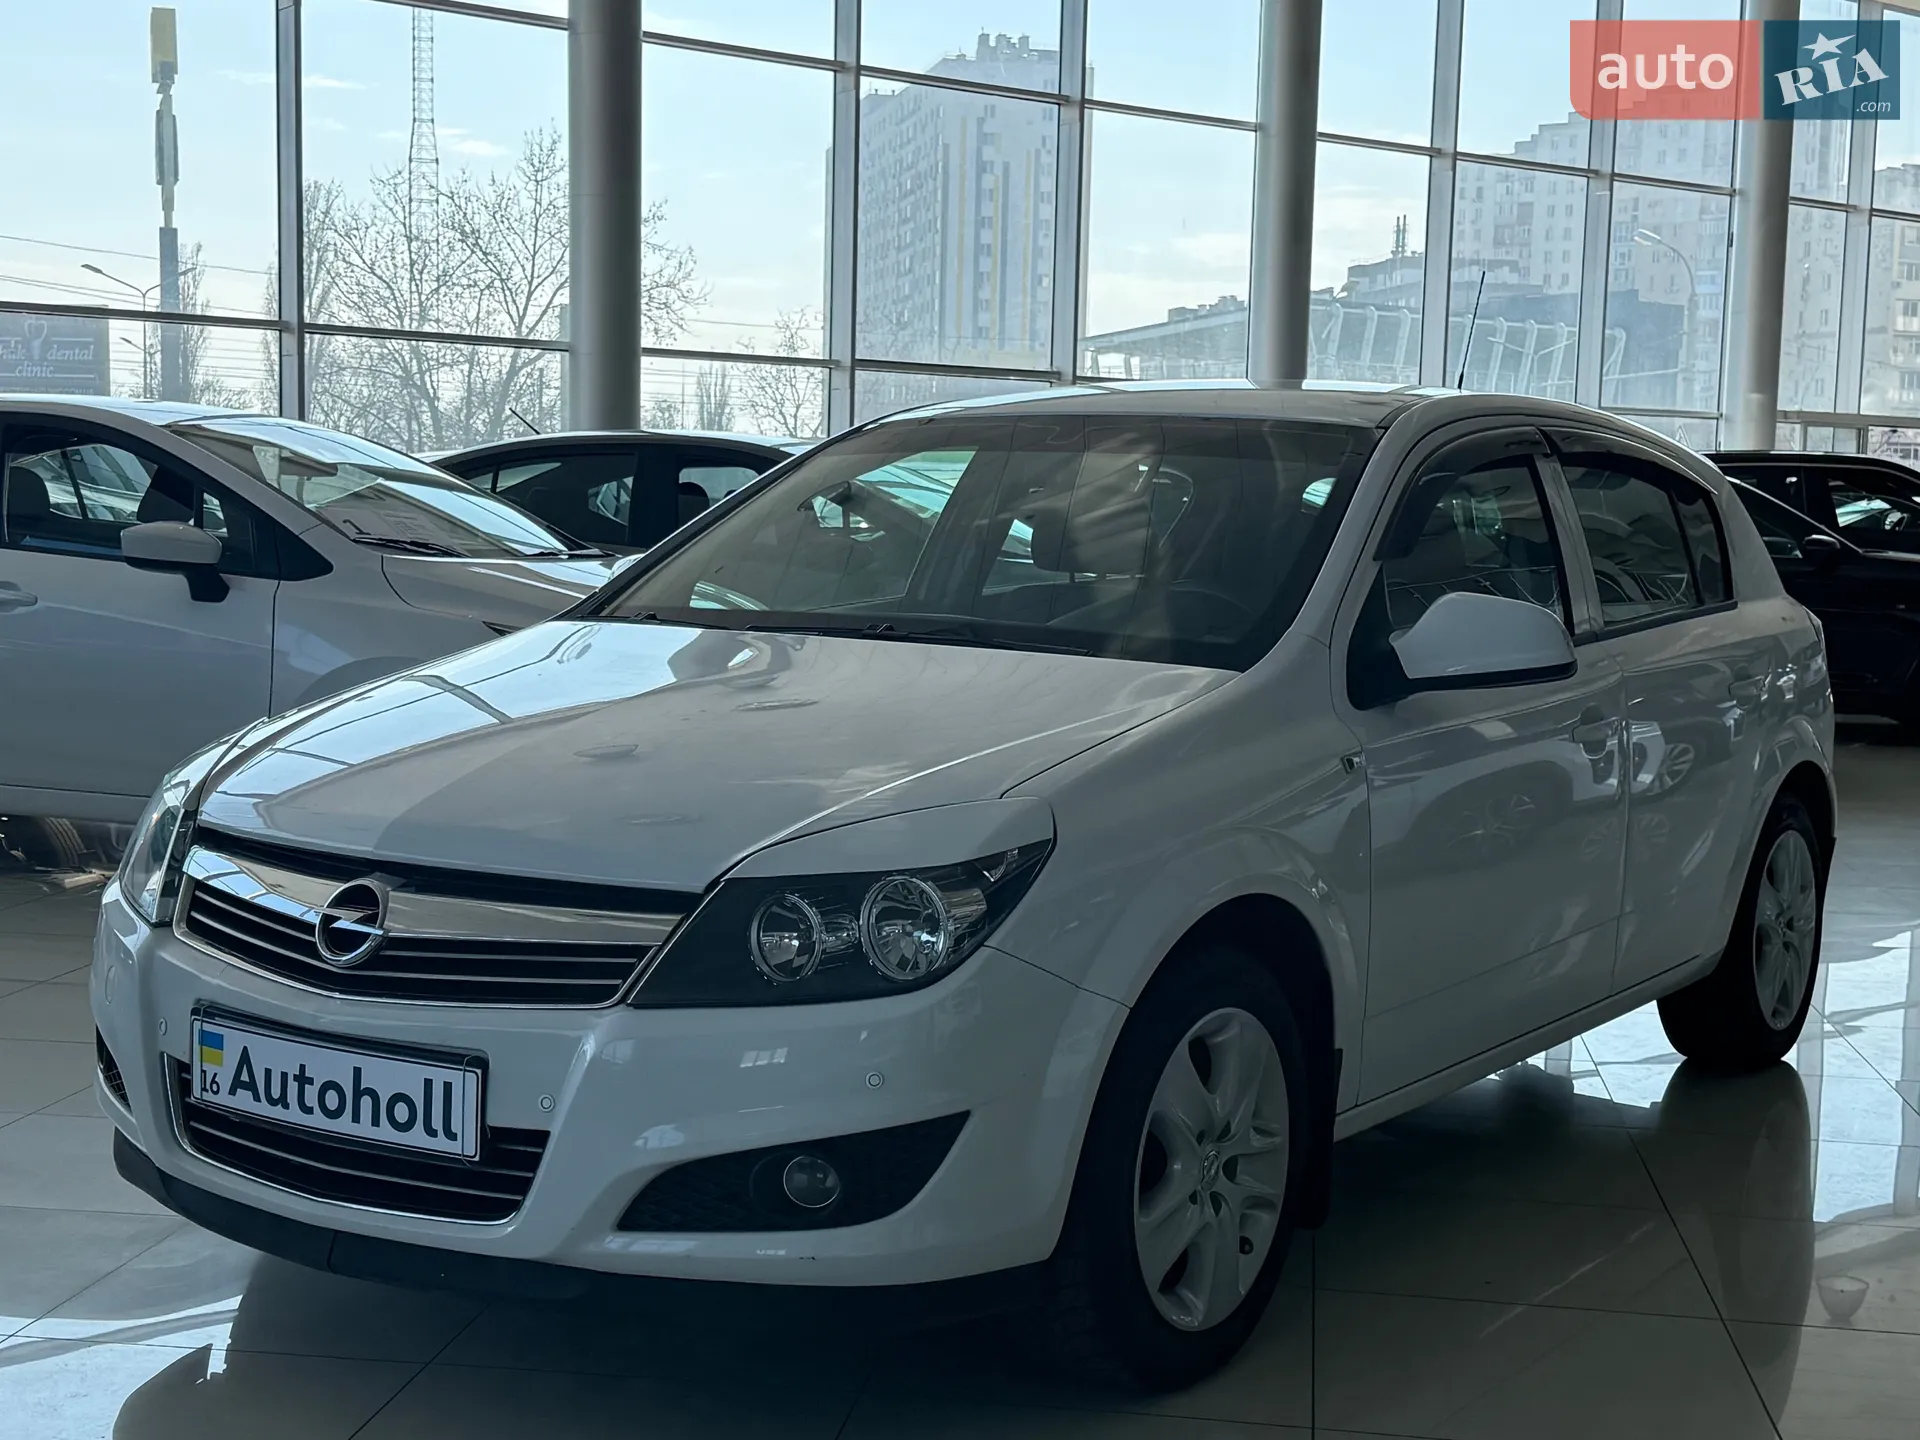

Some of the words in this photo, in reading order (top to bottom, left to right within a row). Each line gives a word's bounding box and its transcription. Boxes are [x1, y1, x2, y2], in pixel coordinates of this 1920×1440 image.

[46, 344, 95, 360] dental
[15, 360, 55, 378] clinic
[201, 1069, 221, 1096] 16
[228, 1045, 458, 1142] Autoholl
